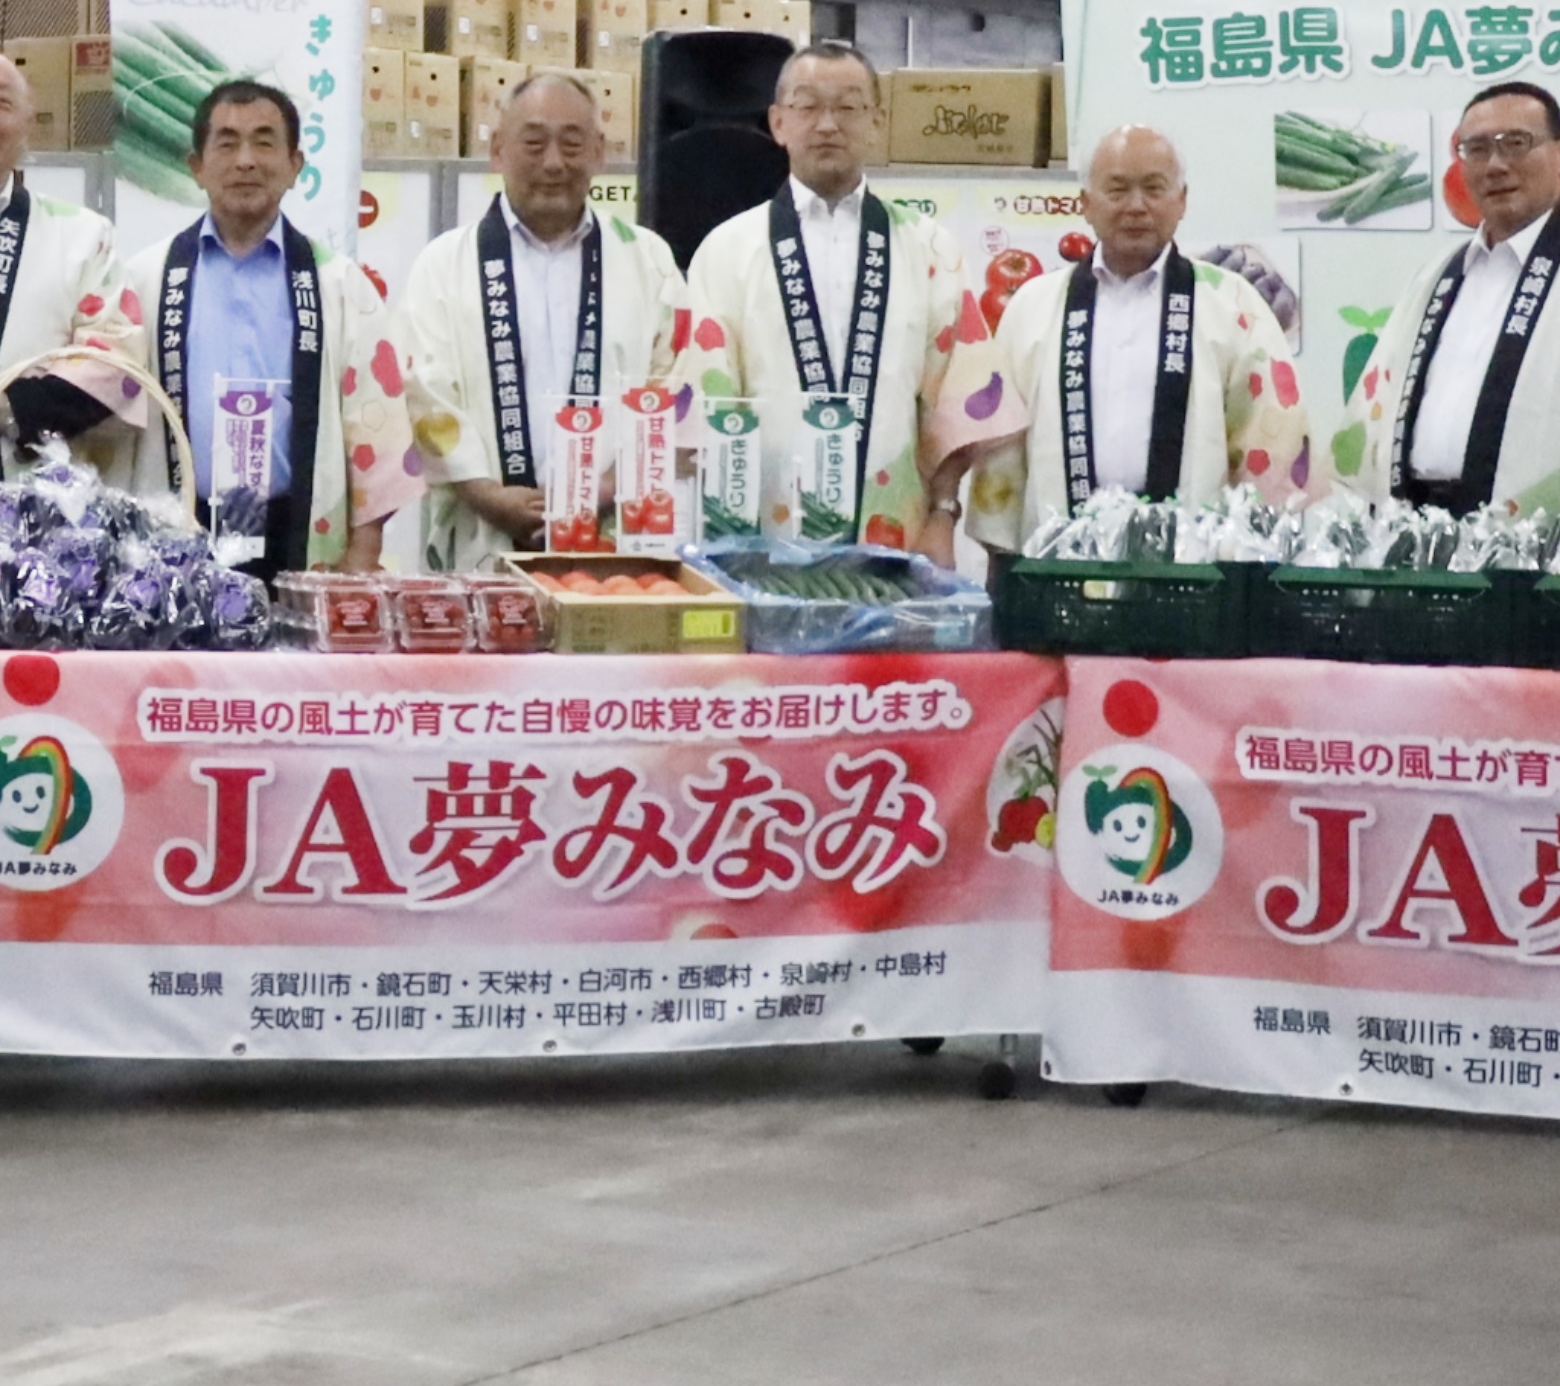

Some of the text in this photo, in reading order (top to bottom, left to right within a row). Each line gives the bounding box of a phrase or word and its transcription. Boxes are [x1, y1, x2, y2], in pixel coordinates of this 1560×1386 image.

[1139, 6, 1347, 83] 福島県
[298, 14, 336, 202] きゅうり
[292, 270, 319, 353] 浅川町長
[1163, 294, 1191, 374] 西郷村長
[1505, 256, 1554, 337] 泉崎村長
[483, 259, 526, 475] 夢みなみ農業協同組合
[730, 436, 748, 507] きゅうり
[826, 433, 843, 503] きゅうり
[146, 689, 963, 736] 福島県の風土が育てた自慢の味覚をお届けします。
[163, 755, 940, 901] JA夢みなみ
[1096, 889, 1180, 906] JA夢みなみ
[147, 971, 225, 996] 福島県
[1253, 1006, 1332, 1036] 福島県
